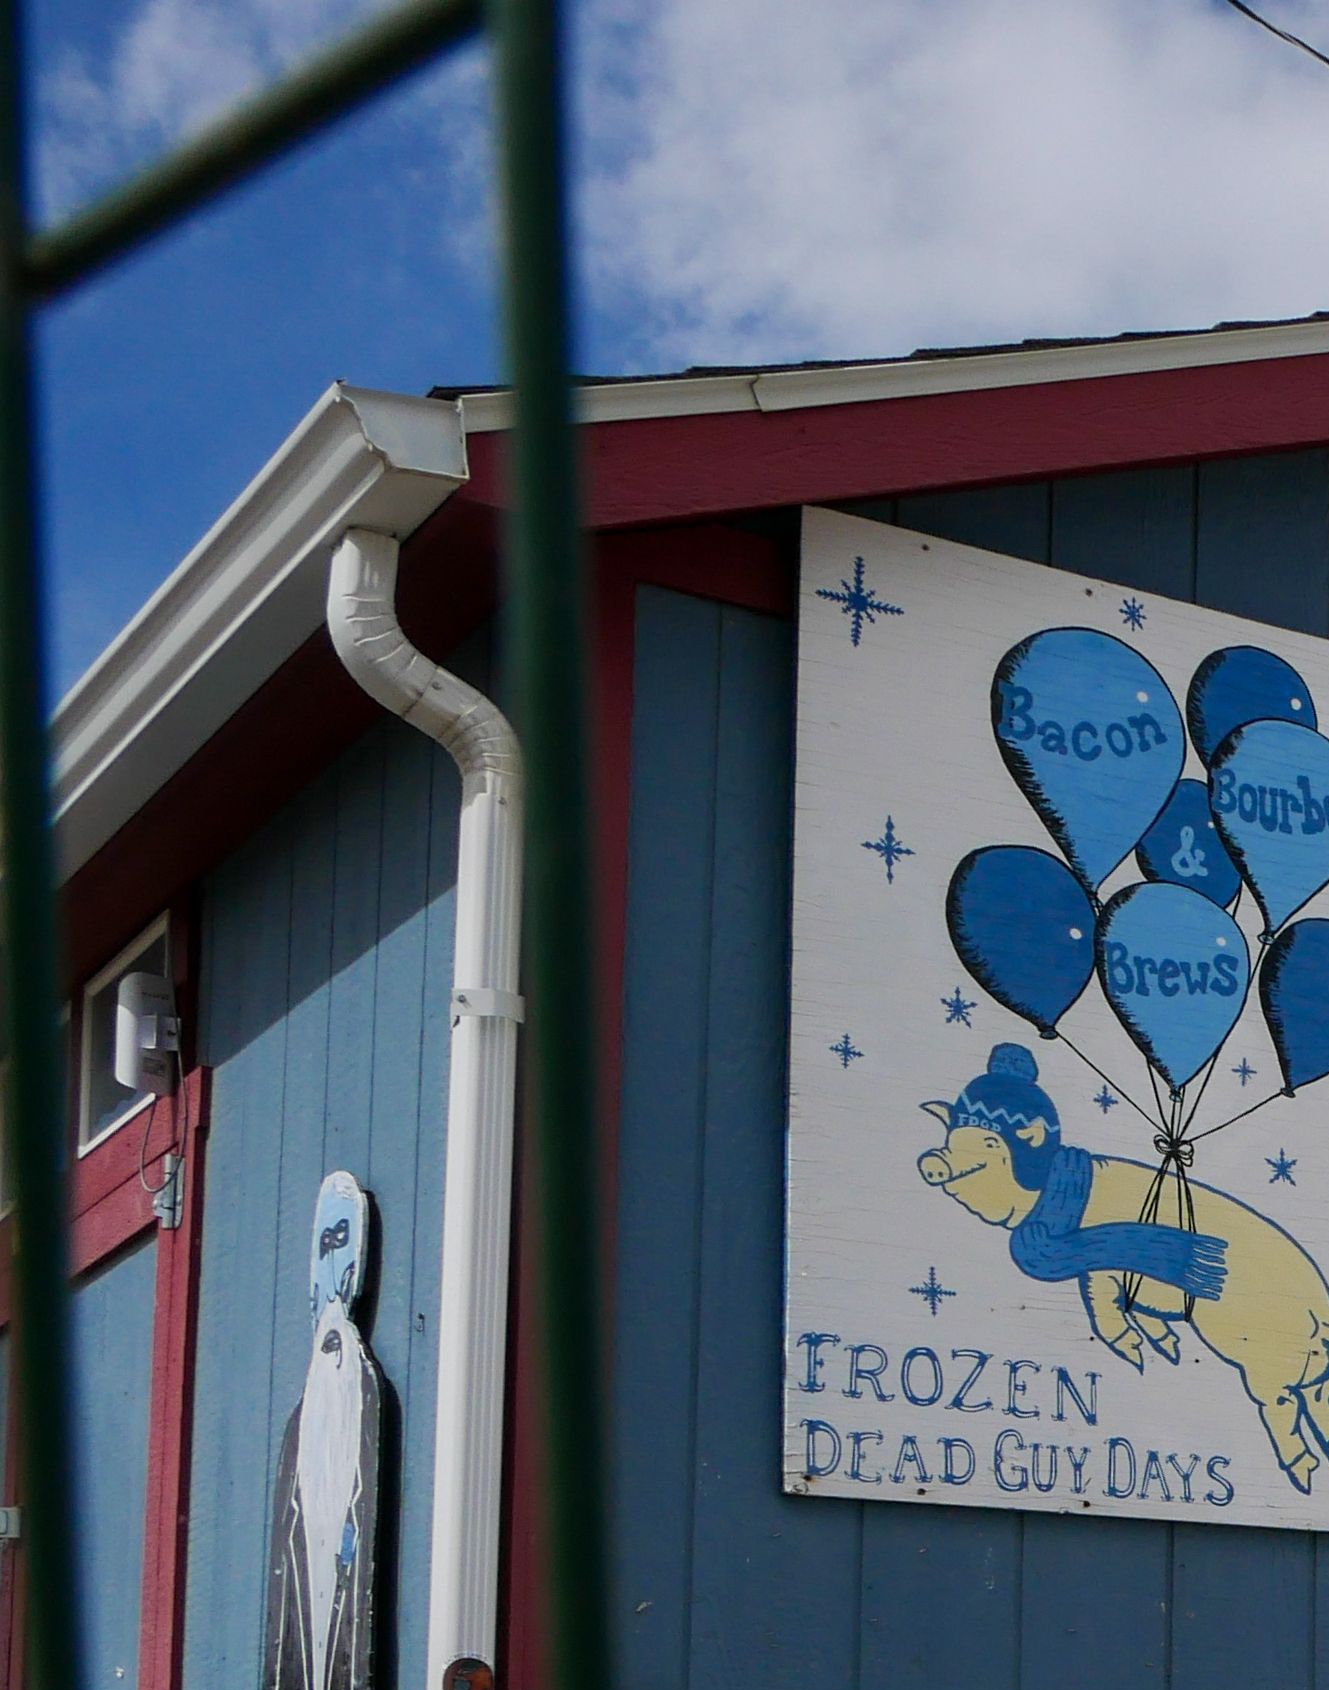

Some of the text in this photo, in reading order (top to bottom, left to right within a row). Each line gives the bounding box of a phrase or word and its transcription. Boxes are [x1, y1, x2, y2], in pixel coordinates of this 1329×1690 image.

[1000, 686, 1168, 760] Bacon
[1171, 826, 1209, 877] &
[1106, 941, 1239, 997] Brews
[797, 1331, 1102, 1426] FROZEN
[799, 1418, 1236, 1506] DEAD GUY DAYS
